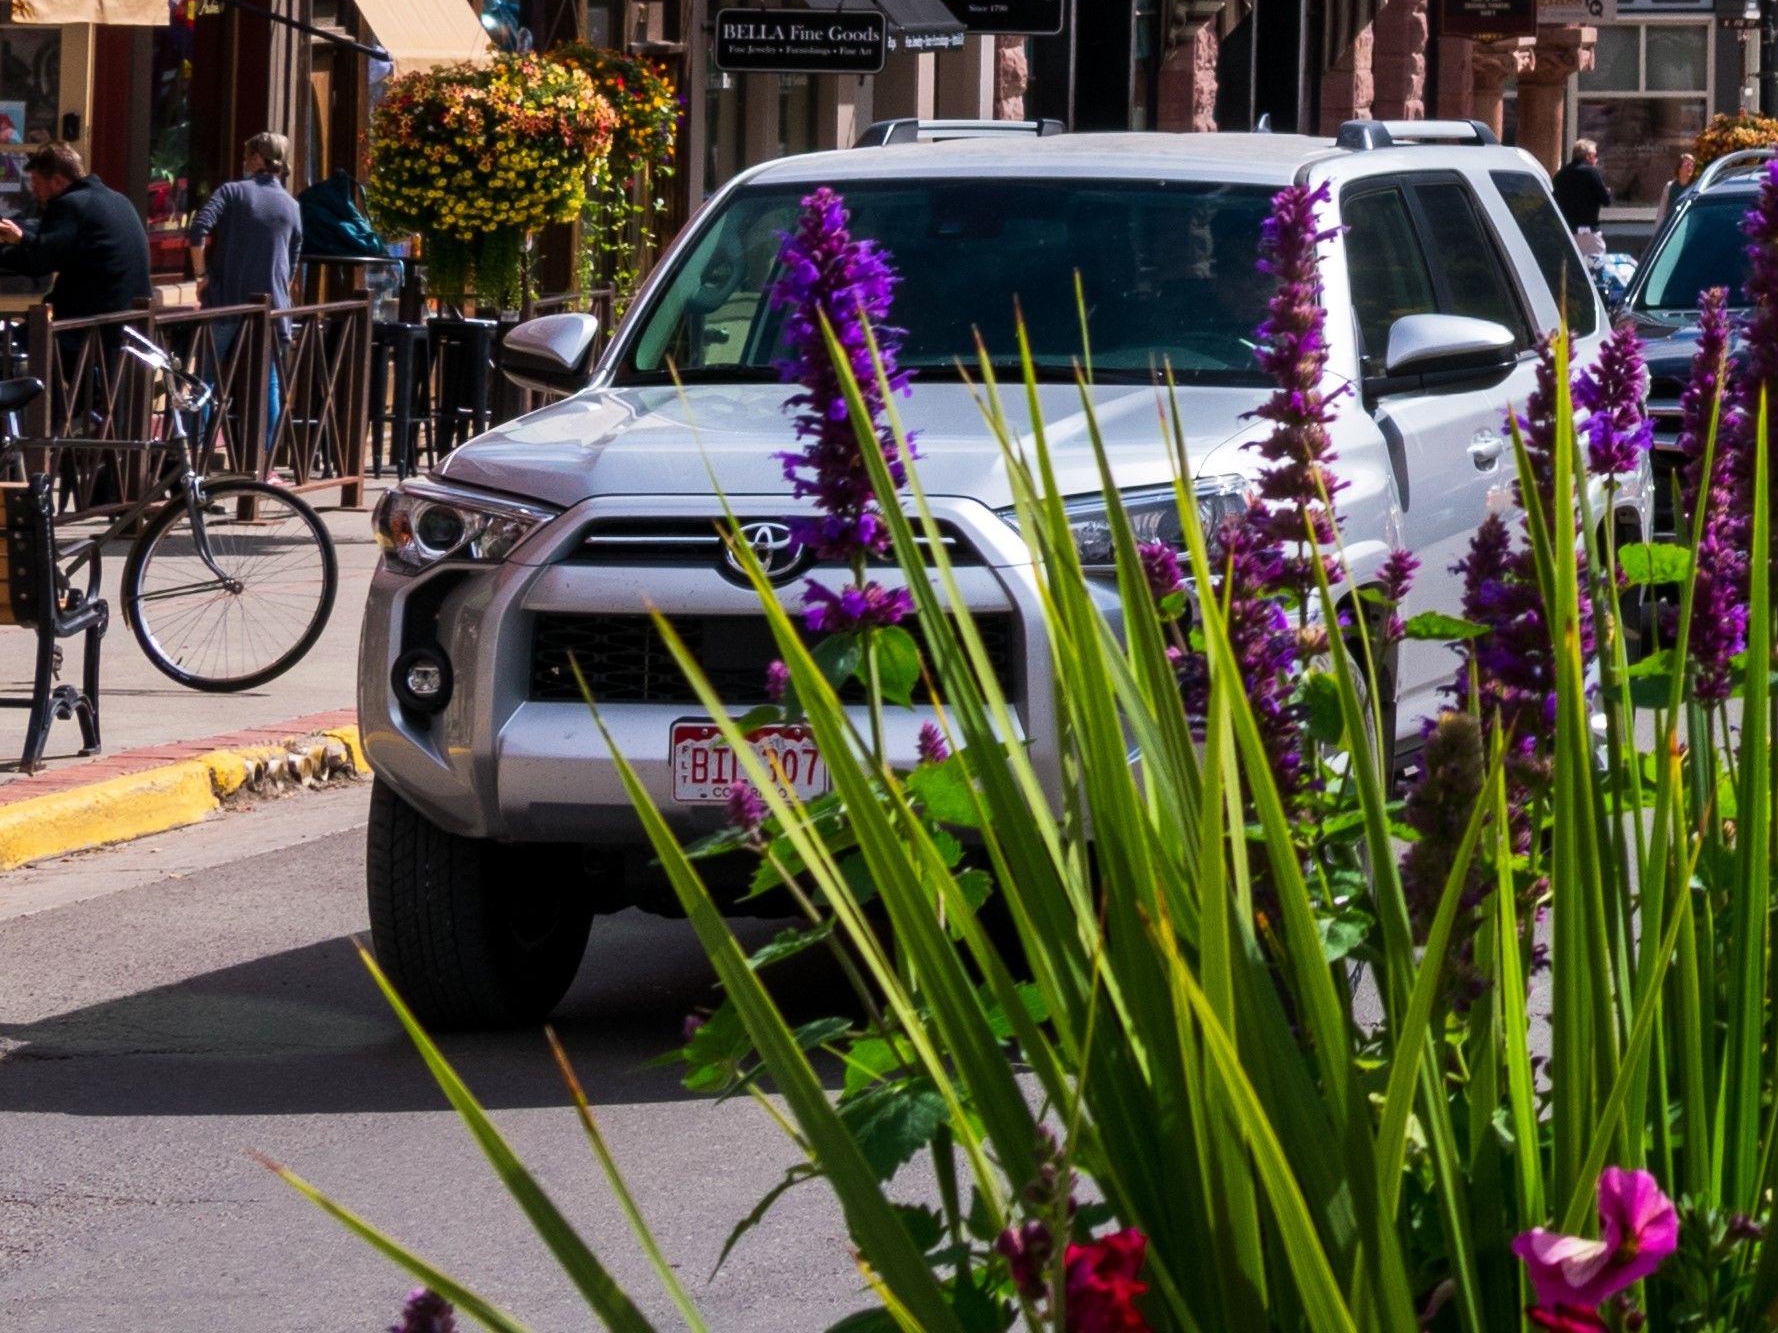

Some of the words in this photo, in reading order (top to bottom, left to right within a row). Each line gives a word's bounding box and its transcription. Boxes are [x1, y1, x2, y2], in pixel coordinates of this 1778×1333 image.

[723, 23, 784, 40] BELLA
[790, 24, 823, 41] Fine
[828, 25, 880, 42] Goods
